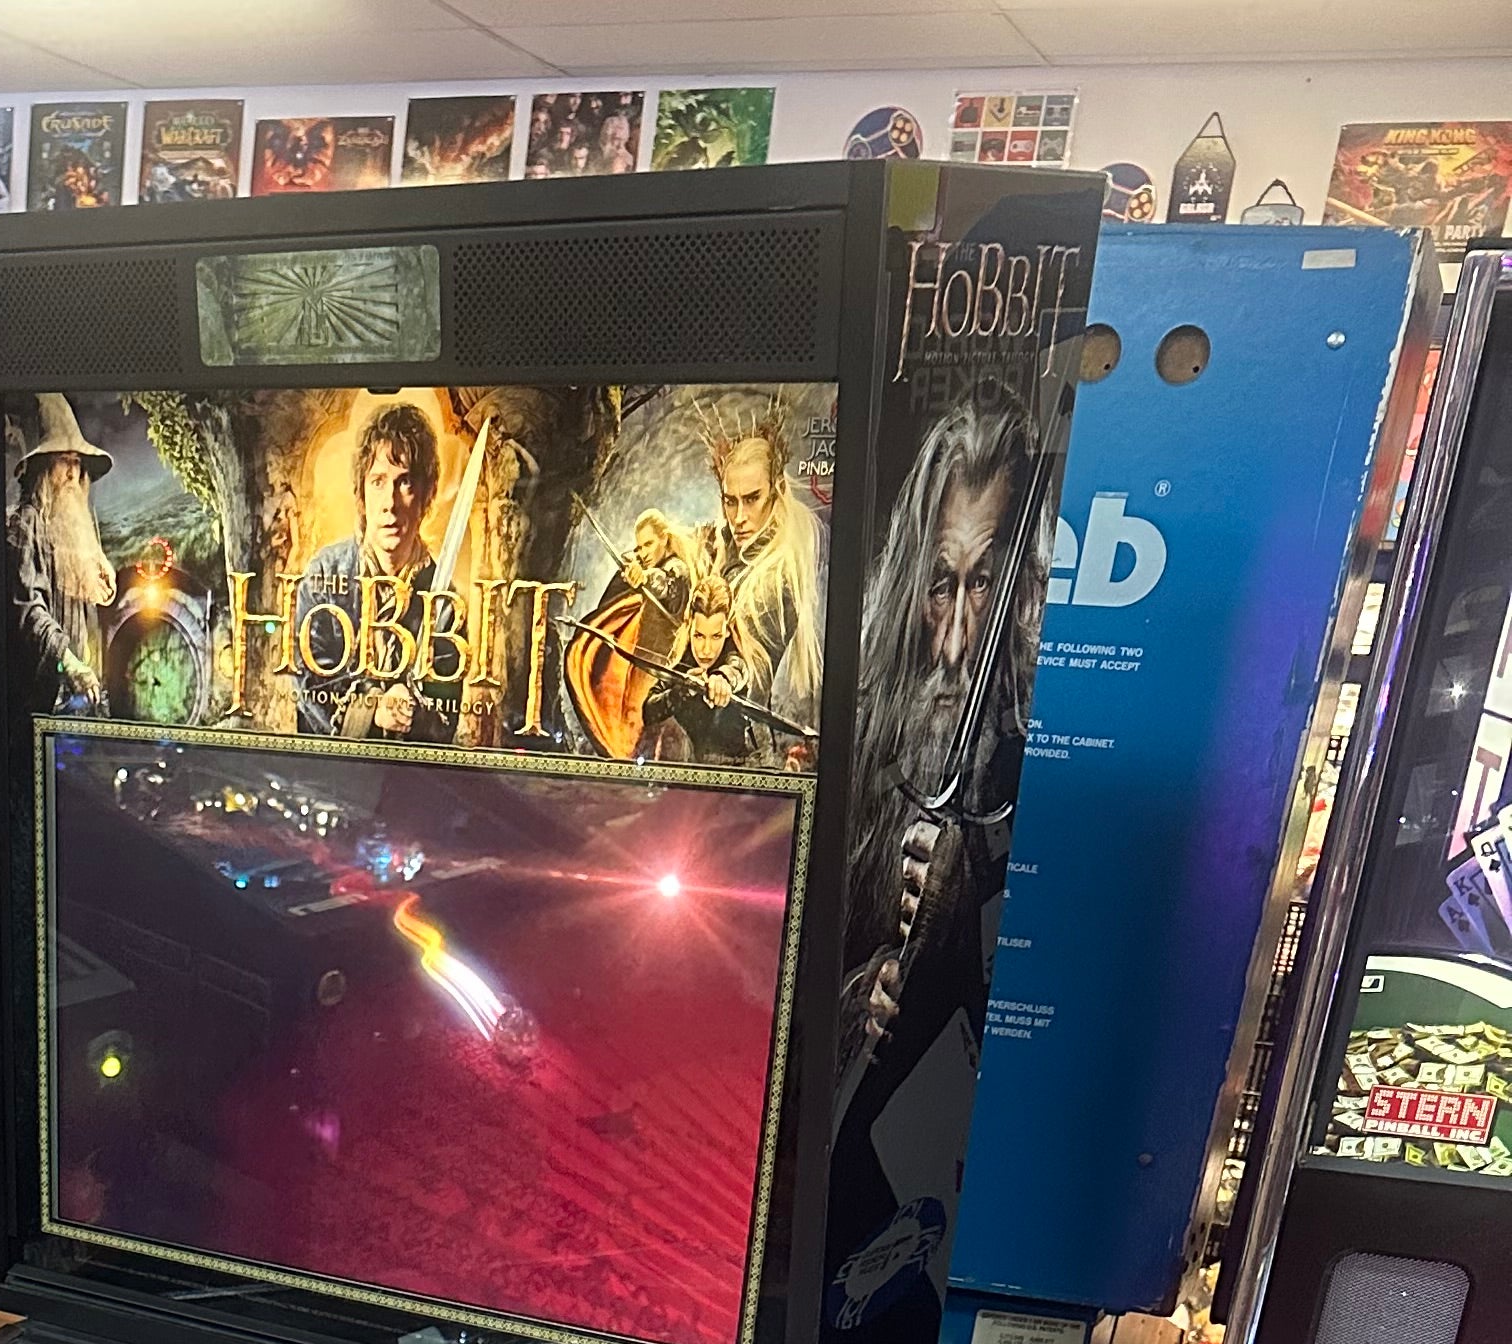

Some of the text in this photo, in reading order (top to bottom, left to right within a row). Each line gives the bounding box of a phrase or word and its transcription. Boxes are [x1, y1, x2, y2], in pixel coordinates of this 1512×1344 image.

[160, 128, 224, 145] WARCRAFT
[1384, 128, 1476, 145] KING KONG
[1444, 225, 1486, 240] PARTY
[892, 241, 1081, 382] HOBBIT
[311, 573, 349, 596] THE
[225, 572, 577, 737] HOBBIT
[1039, 642, 1143, 658] HE FOLLOWING TWO
[1037, 656, 1141, 672] EVICE MUST ACCEPT
[277, 691, 340, 705] MOTION
[425, 697, 494, 716] TRILOGY
[1037, 734, 1115, 749] TO THE CABINET.
[1025, 747, 1071, 759] ROVIDED.
[1006, 862, 1039, 874] TICALE
[997, 936, 1032, 949] TILISER
[988, 999, 1055, 1016] PVERSCHLUSS
[1004, 1014, 1032, 1026] MUSS
[1034, 1017, 1052, 1028] MIT
[991, 1027, 1032, 1040] WERDEN.
[1370, 1089, 1491, 1127] STERN
[1448, 1127, 1487, 1142] INC.
